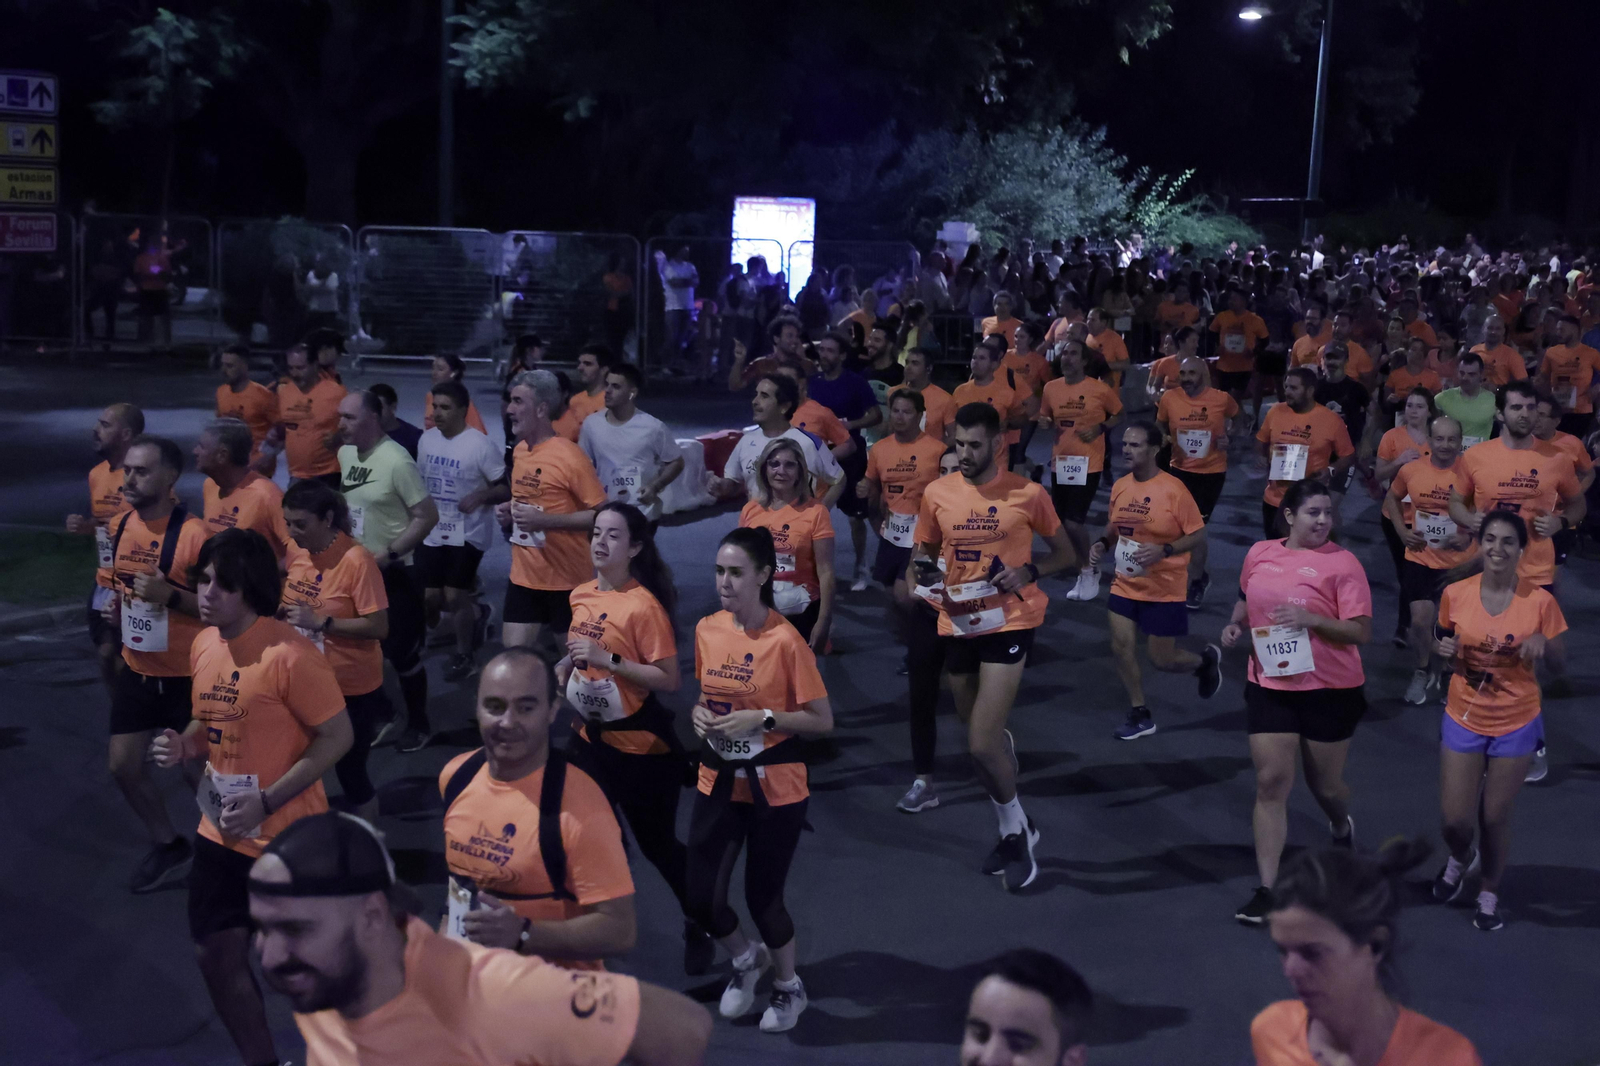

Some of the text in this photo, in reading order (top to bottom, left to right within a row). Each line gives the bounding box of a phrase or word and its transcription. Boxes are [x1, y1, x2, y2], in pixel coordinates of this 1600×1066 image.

[9, 185, 53, 201] Armas
[9, 216, 53, 231] Forum
[4, 231, 52, 247] Sevilla
[1186, 438, 1203, 448] 7285
[426, 454, 460, 469] TEAVIAL
[345, 465, 373, 483] RUN
[1063, 465, 1082, 474] 12549
[612, 477, 635, 487] 13053
[890, 522, 910, 534] 16934
[1426, 524, 1446, 536] 3451
[961, 599, 987, 613] 1264
[1288, 596, 1307, 606] POR
[128, 615, 152, 632] 7606
[1266, 640, 1298, 656] 11837
[706, 668, 734, 680] SEVILLA
[720, 665, 754, 675] NOCTURNA
[199, 692, 223, 702] SEVILLA
[212, 684, 240, 696] NOCTURNA
[576, 691, 610, 708] 13959
[715, 736, 751, 754] 13955
[450, 839, 486, 859] SEVILLA
[469, 836, 515, 856] NOCTURNA
